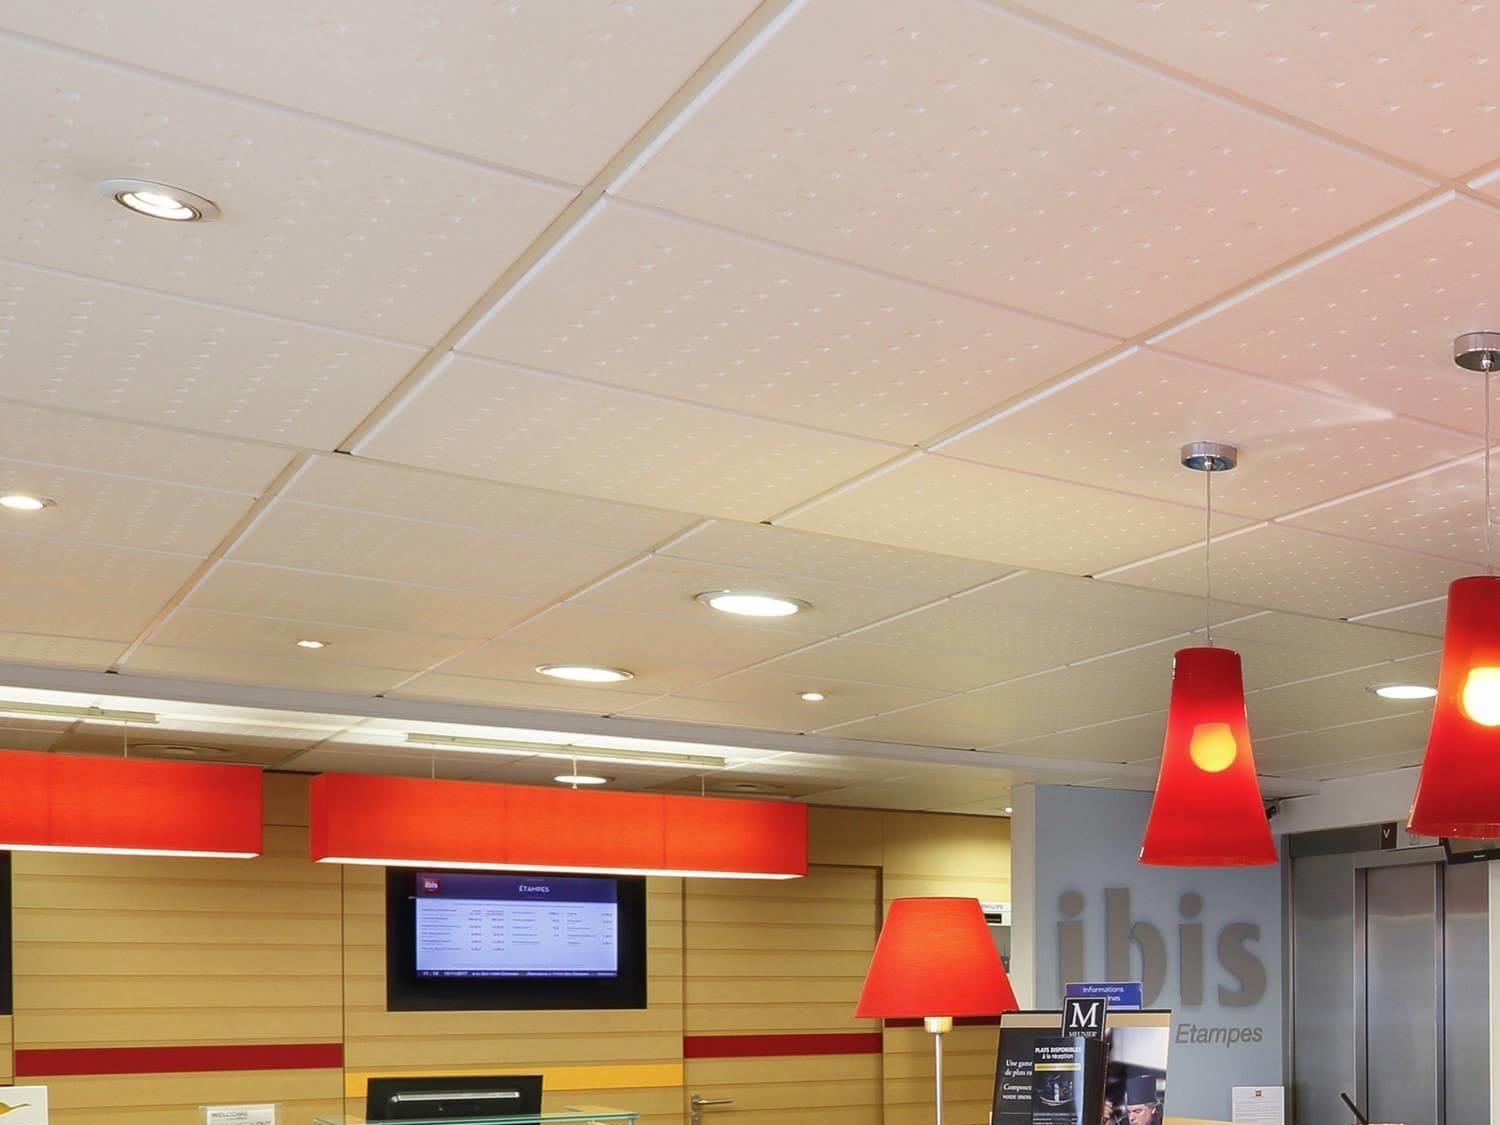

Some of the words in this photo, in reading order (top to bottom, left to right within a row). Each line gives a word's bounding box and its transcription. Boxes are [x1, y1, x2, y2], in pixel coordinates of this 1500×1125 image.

[1057, 887, 1266, 1008] ibis
[1083, 986, 1124, 994] Informations
[1070, 1002, 1100, 1028] M
[1175, 1023, 1263, 1049] Etampes
